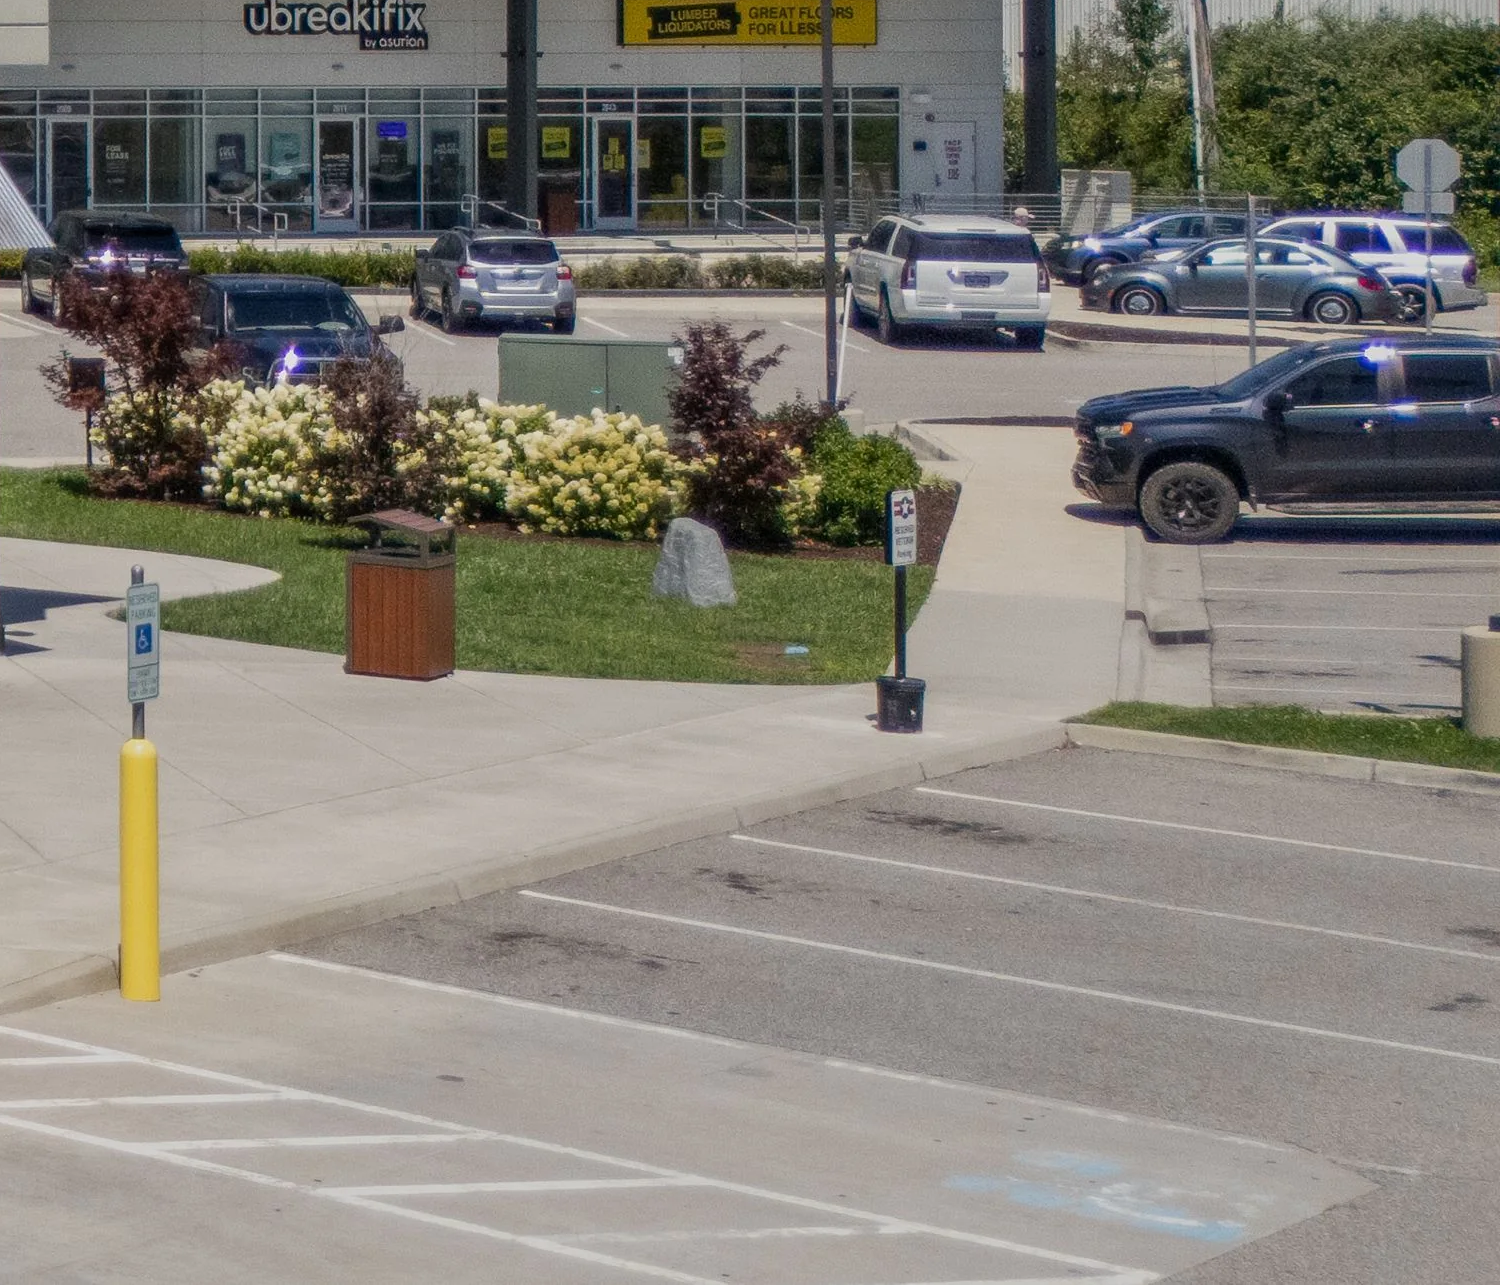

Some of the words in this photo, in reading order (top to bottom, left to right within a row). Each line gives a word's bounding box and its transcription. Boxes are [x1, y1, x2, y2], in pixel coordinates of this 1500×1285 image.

[670, 8, 718, 22] LUMBER
[748, 6, 797, 20] GREAT
[657, 18, 732, 34] LIQUIDATORS
[749, 23, 777, 35] FOR
[364, 38, 377, 49] by
[379, 34, 426, 49] asurion
